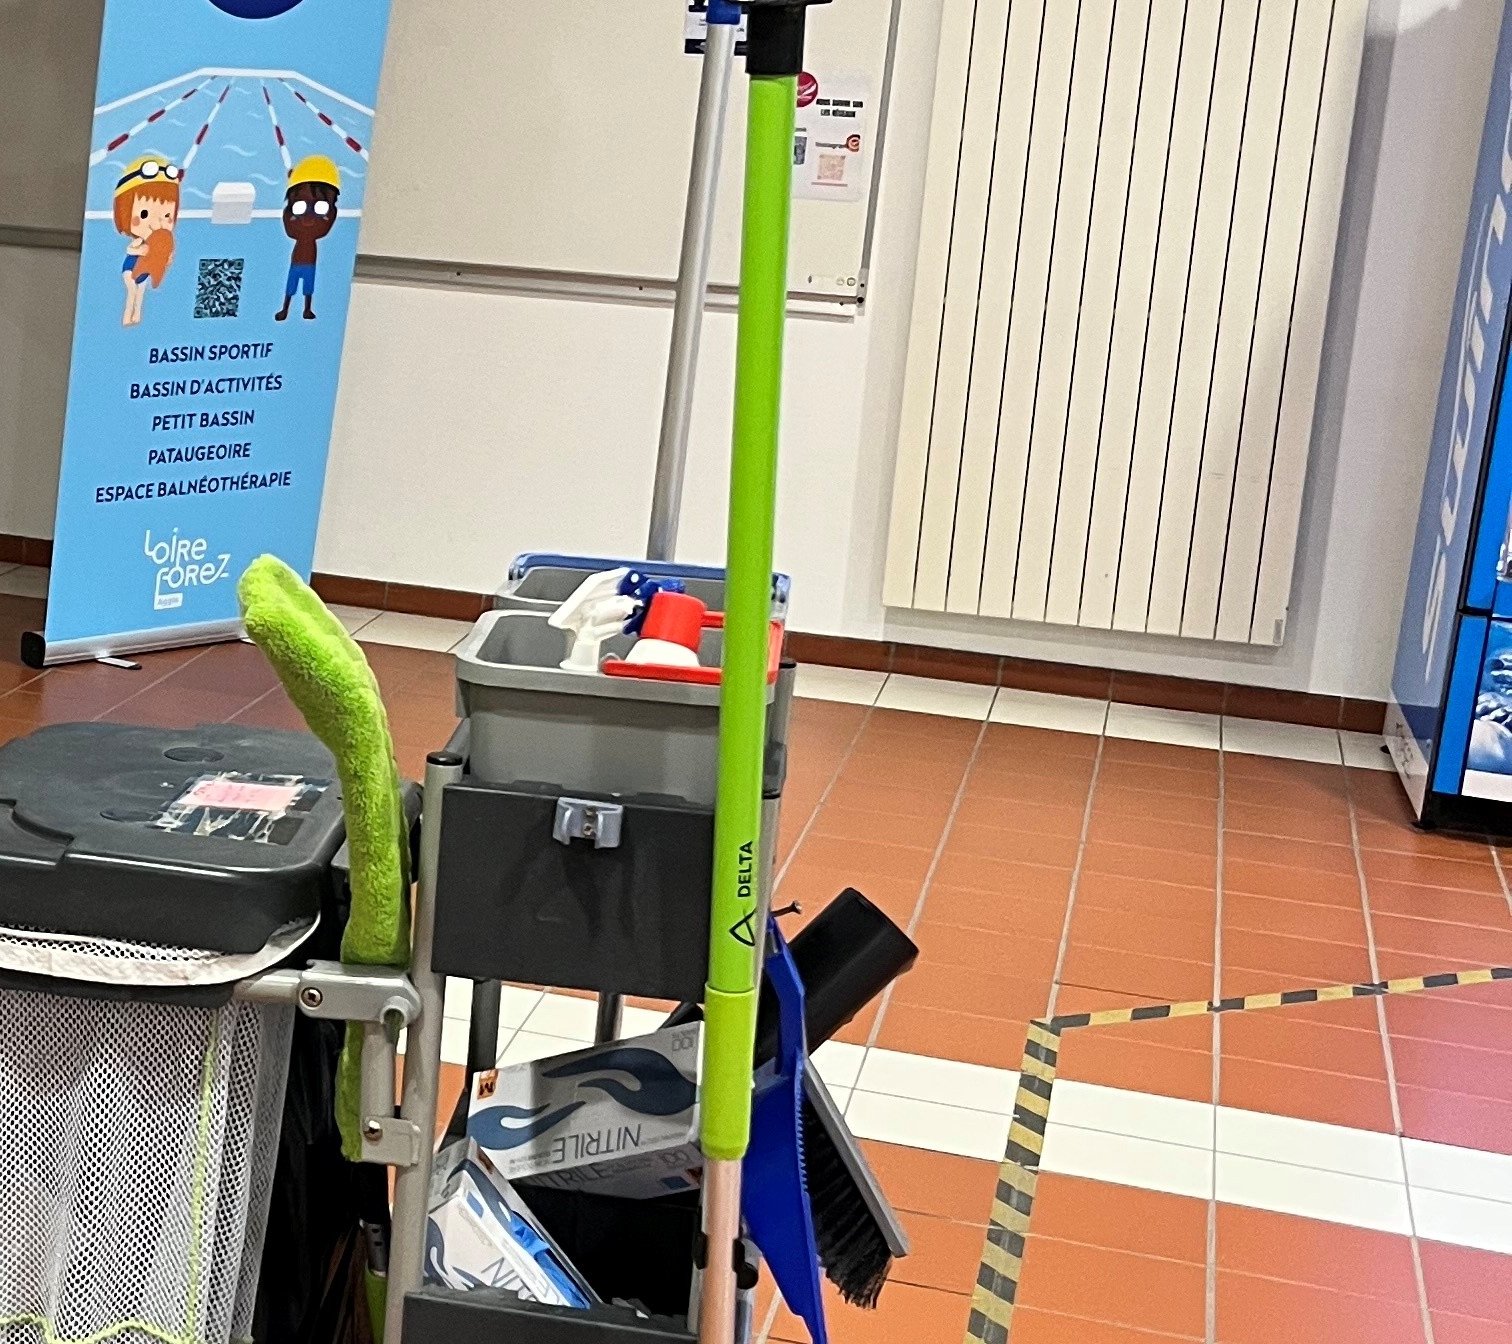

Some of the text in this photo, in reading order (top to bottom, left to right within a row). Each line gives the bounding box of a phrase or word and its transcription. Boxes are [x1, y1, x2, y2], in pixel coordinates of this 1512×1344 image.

[149, 342, 274, 364] BASSIN SPORTIF
[129, 373, 283, 399] BASSIN D'ACTIVITÉS
[152, 409, 255, 432] PETIT BASSIN
[148, 442, 252, 465] PATAUGEOIRE
[95, 471, 292, 503] ESPACE BALNÉOTHÉRAPIE
[737, 840, 753, 898] DELTA
[552, 1123, 641, 1164] NITRILE
